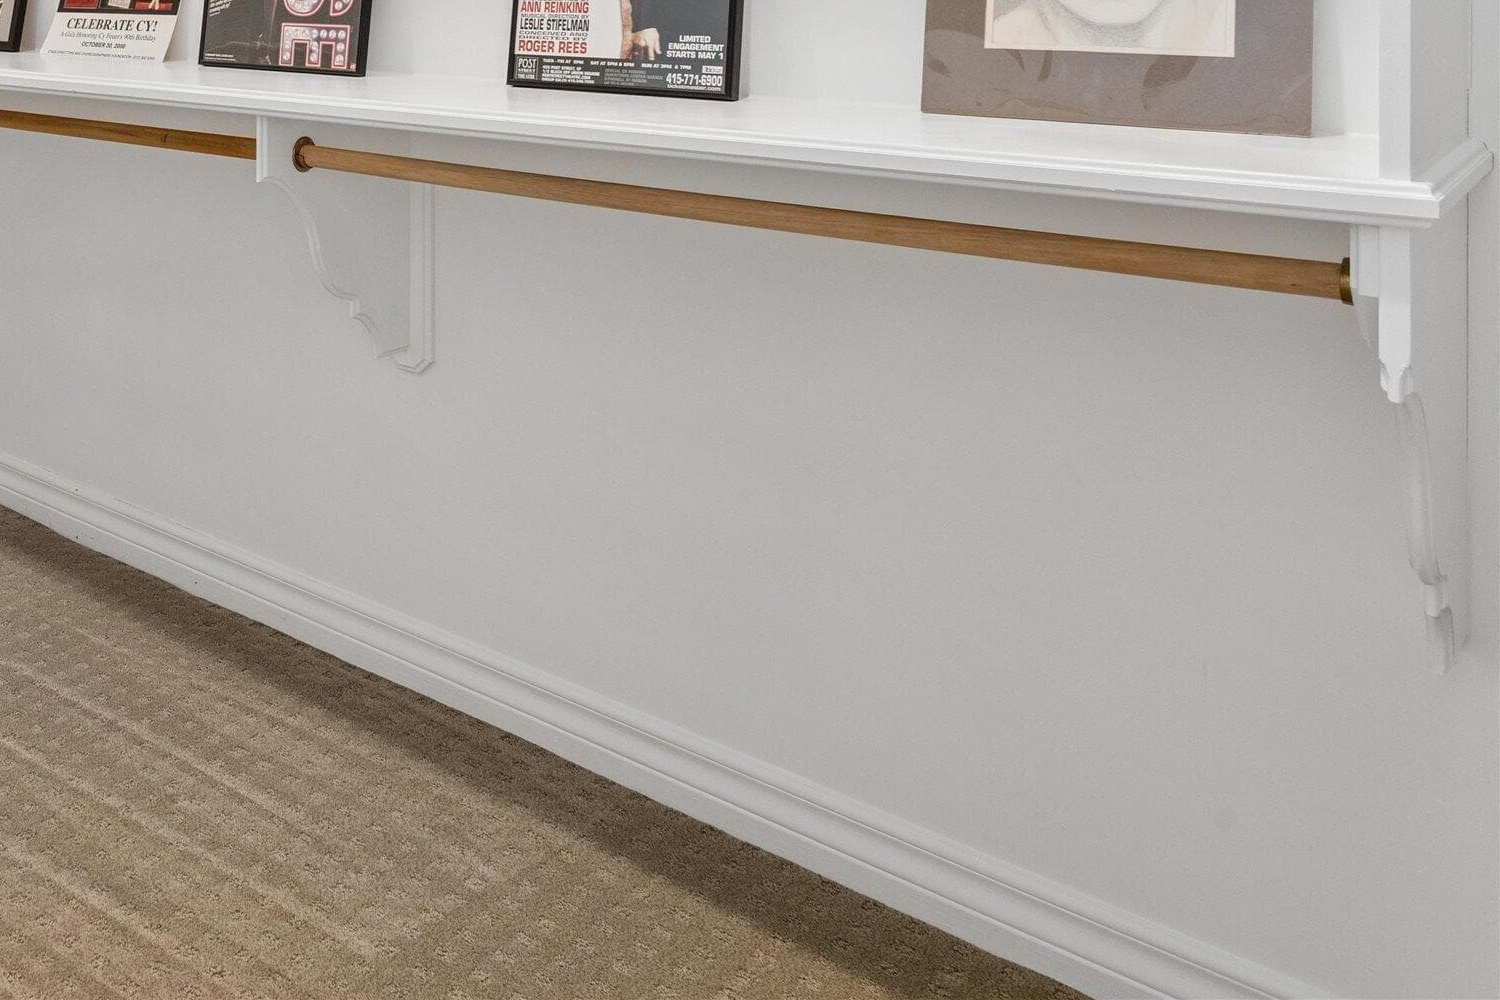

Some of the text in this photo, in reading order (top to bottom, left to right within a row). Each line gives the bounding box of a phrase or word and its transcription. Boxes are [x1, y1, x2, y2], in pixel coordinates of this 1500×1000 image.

[520, 2, 590, 14] ANN REINKING
[67, 18, 158, 32] CELEBRATE CY!
[520, 18, 590, 32] LESLIE STIFELMAN
[679, 34, 711, 42] LIMITED
[518, 40, 588, 54] ROGER REES
[668, 42, 724, 52] ENGAGEMENT
[666, 50, 696, 58] STARTS
[518, 58, 537, 68] POST
[666, 73, 722, 86] 415-771-6900
